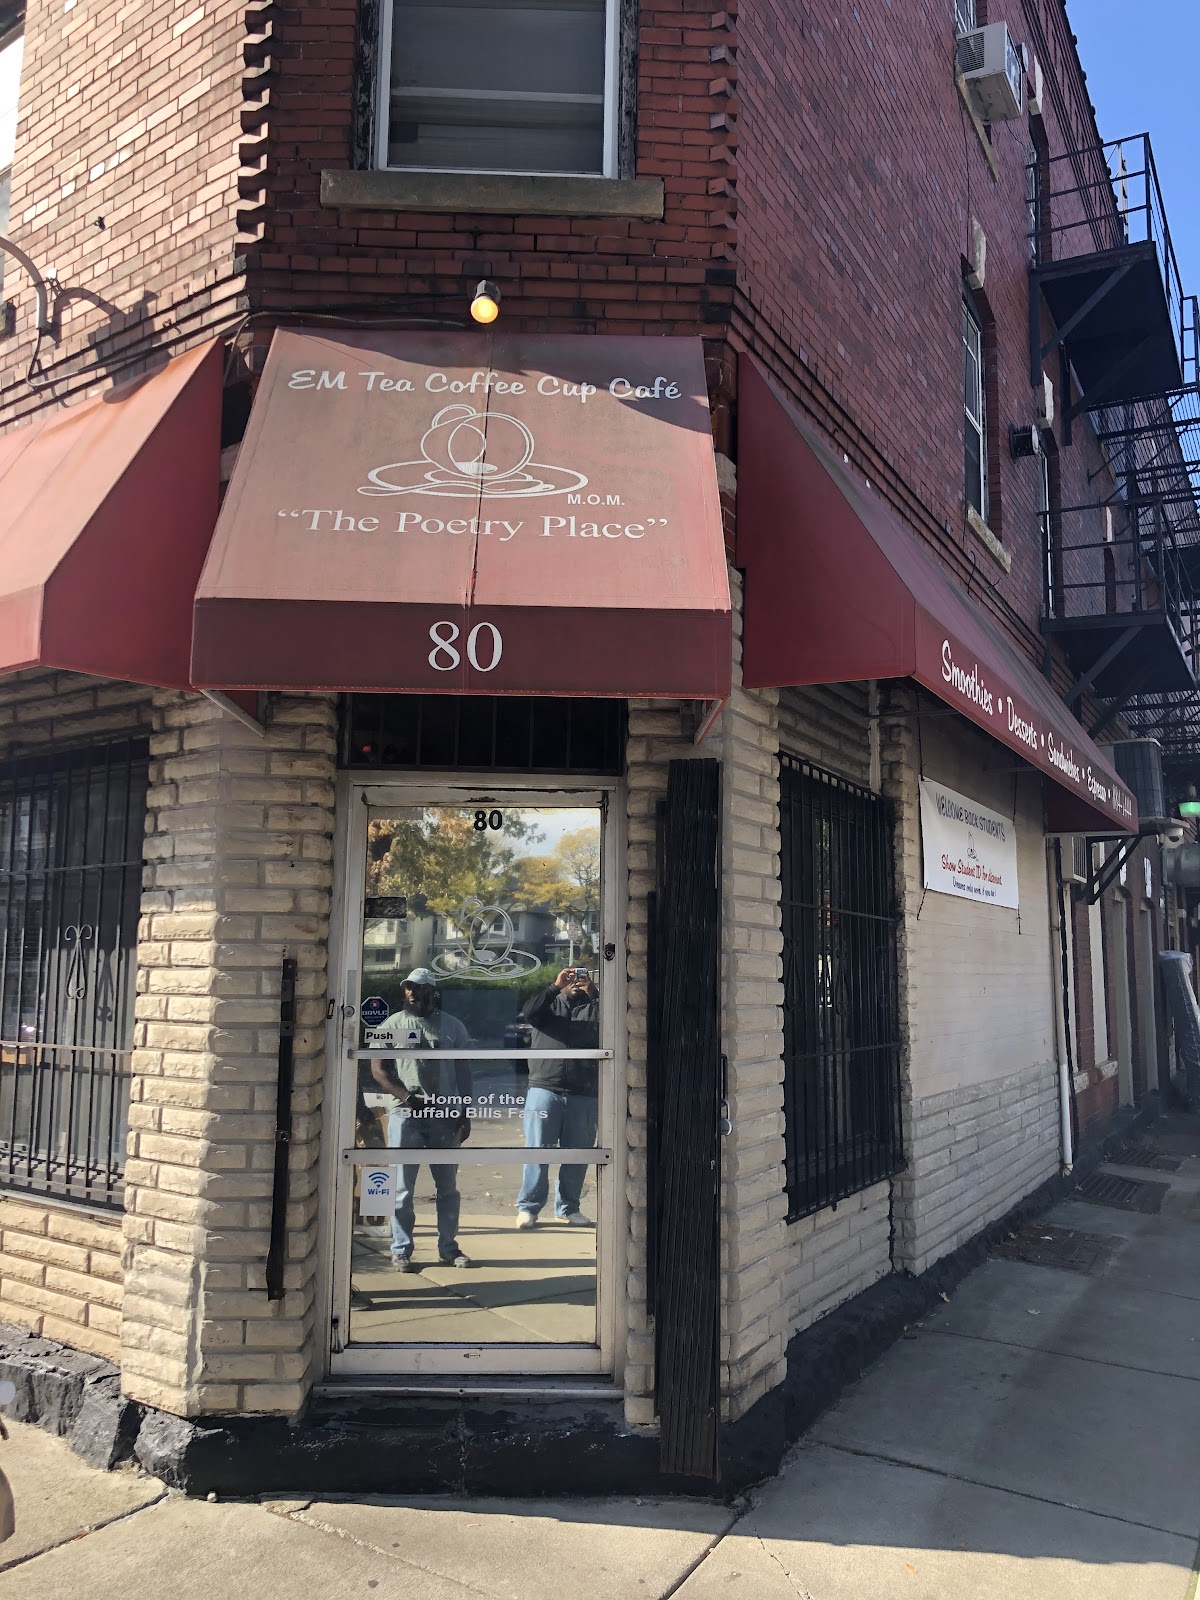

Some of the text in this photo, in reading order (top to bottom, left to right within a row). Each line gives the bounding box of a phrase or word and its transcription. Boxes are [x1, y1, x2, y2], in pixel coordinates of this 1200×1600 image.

[288, 370, 682, 403] EM Tea Coffee Cup Café
[567, 494, 625, 506] M.O.M.
[393, 512, 525, 541] Poetry
[427, 621, 503, 672] 80
[941, 639, 993, 716] Smoothies
[1006, 696, 1038, 750] Desserts
[1047, 731, 1080, 784] Sandwiches
[473, 810, 503, 831] 80
[979, 815, 1006, 843] STUDENTS
[941, 854, 956, 872] Show
[957, 858, 975, 878] Student
[366, 1031, 394, 1040] Push
[424, 1093, 526, 1105] Home of the
[400, 1107, 549, 1119] Buffalo Bills Fans
[367, 1188, 390, 1196] Wi-Fi
